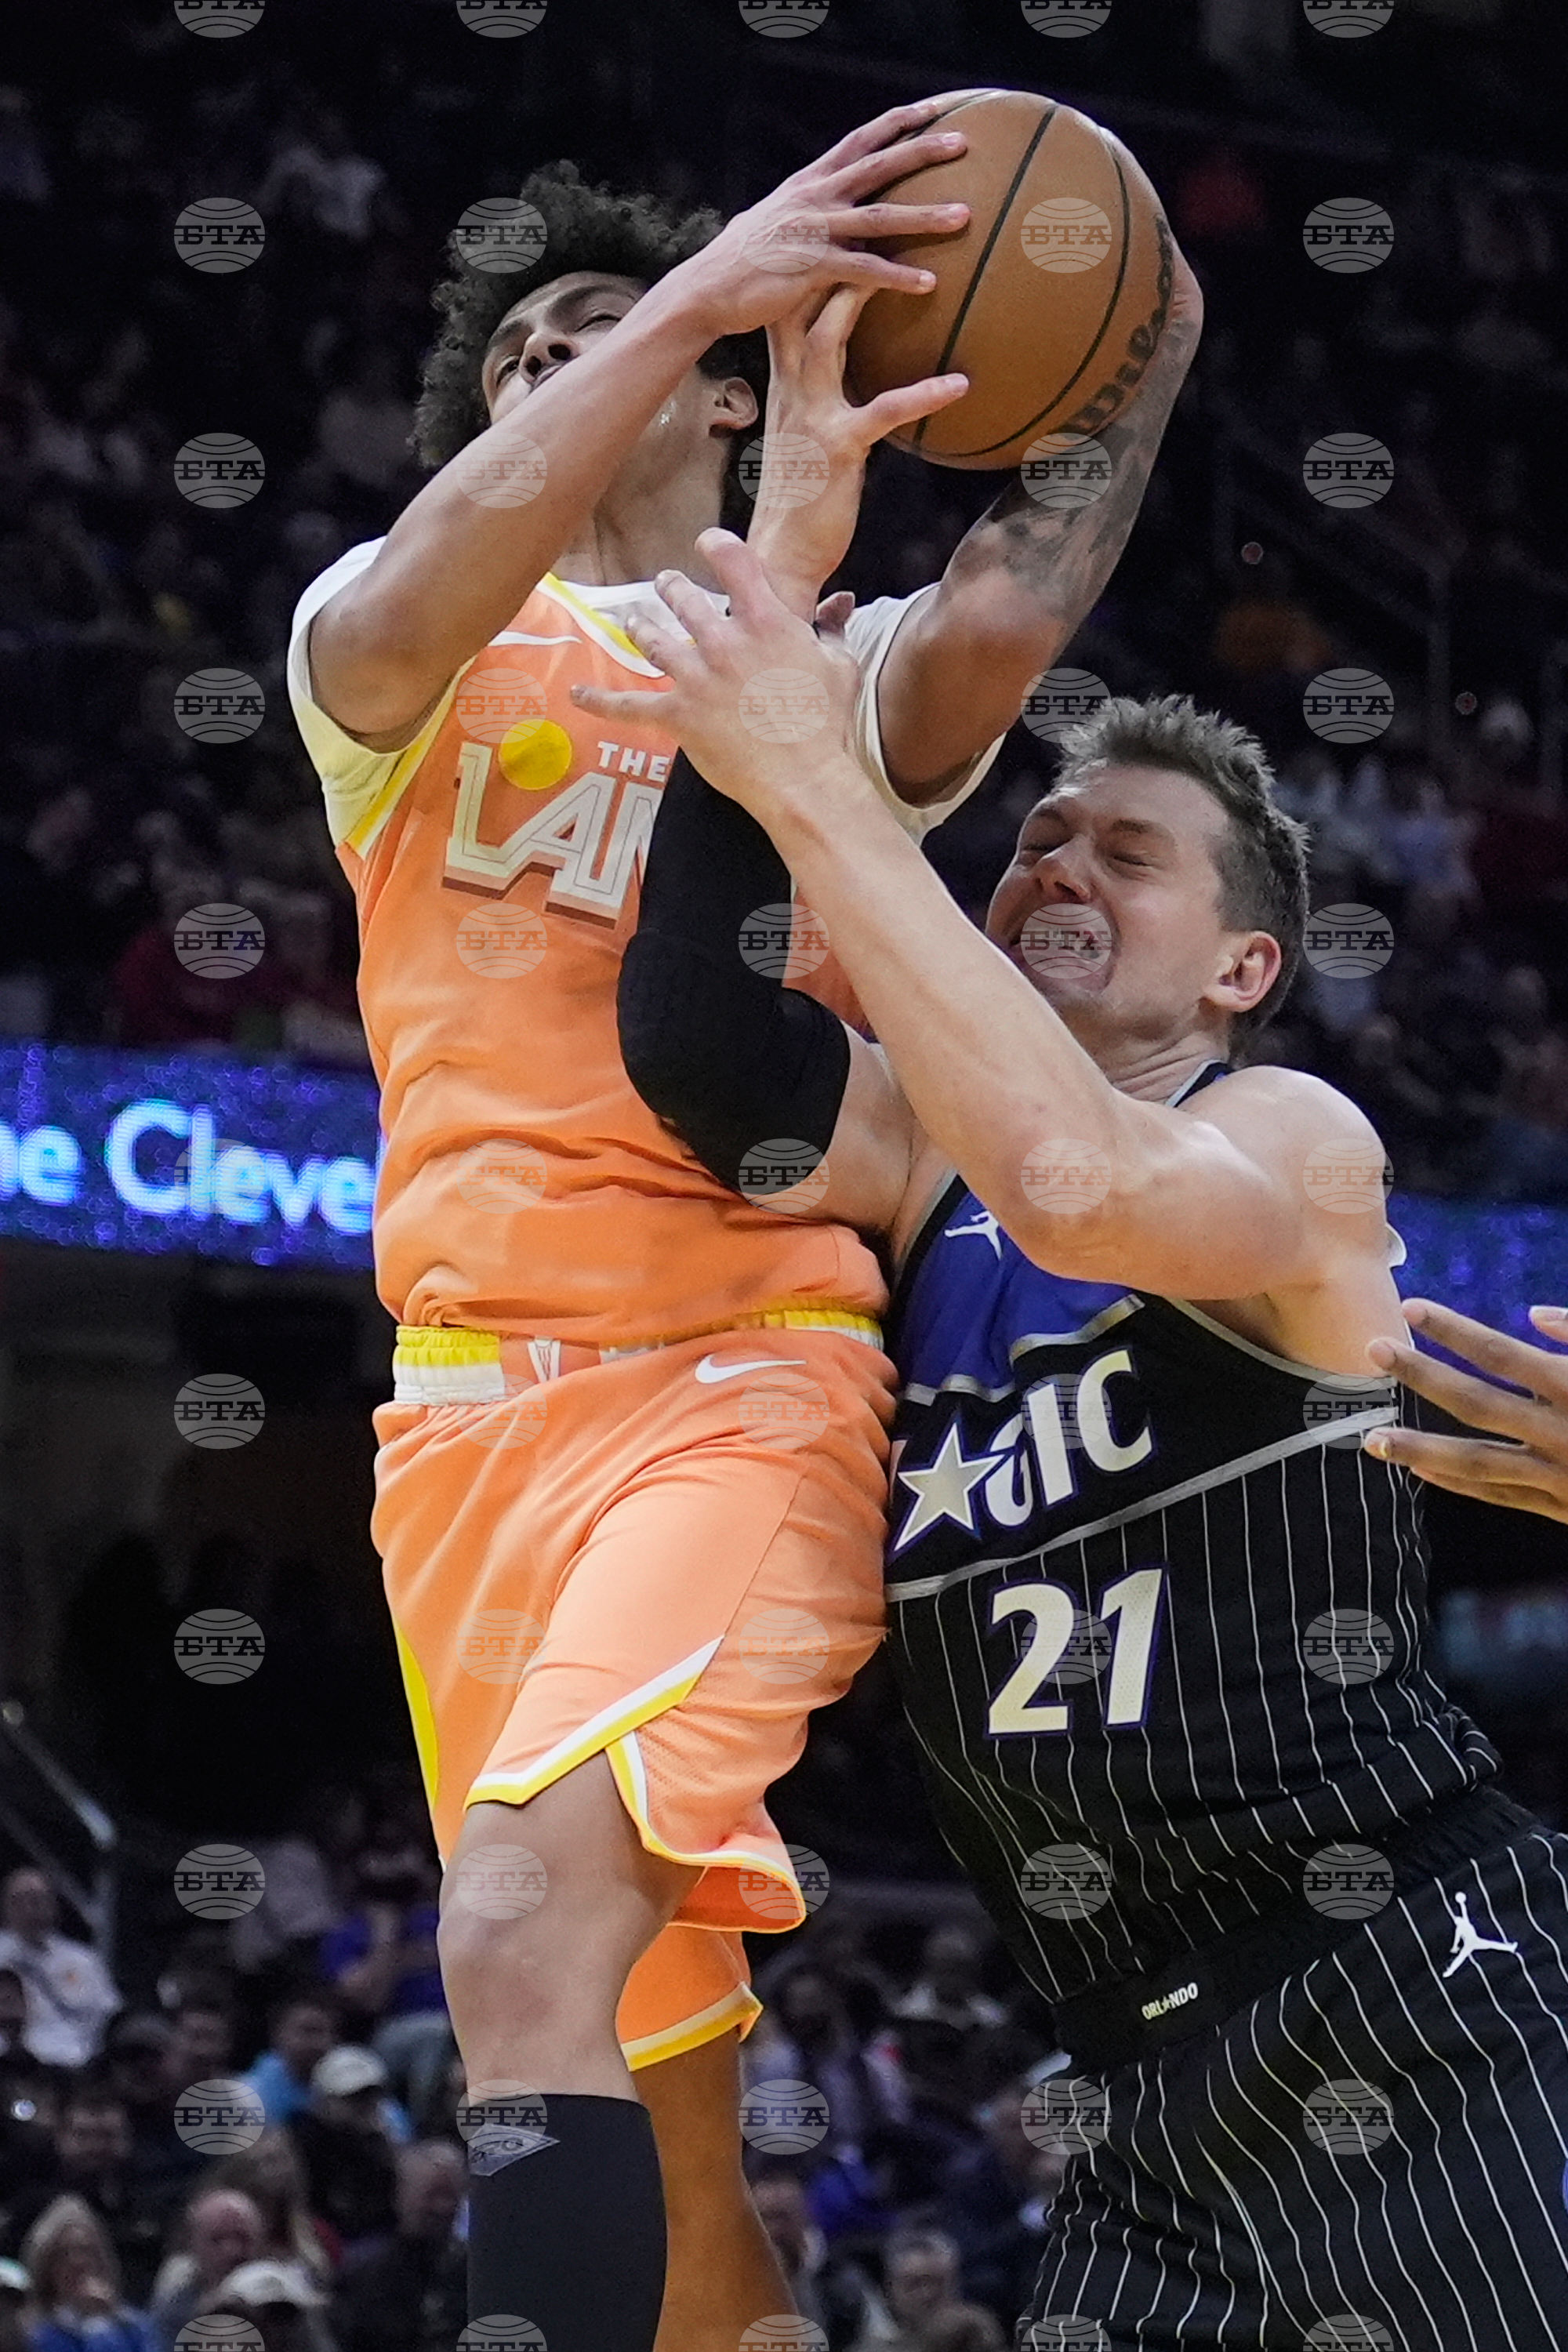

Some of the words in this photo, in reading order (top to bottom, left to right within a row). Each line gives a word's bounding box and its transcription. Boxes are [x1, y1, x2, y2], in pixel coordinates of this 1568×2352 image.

[597, 741, 671, 782] THE
[105, 1098, 383, 1236] Cleve
[987, 1568, 1163, 1735] 21
